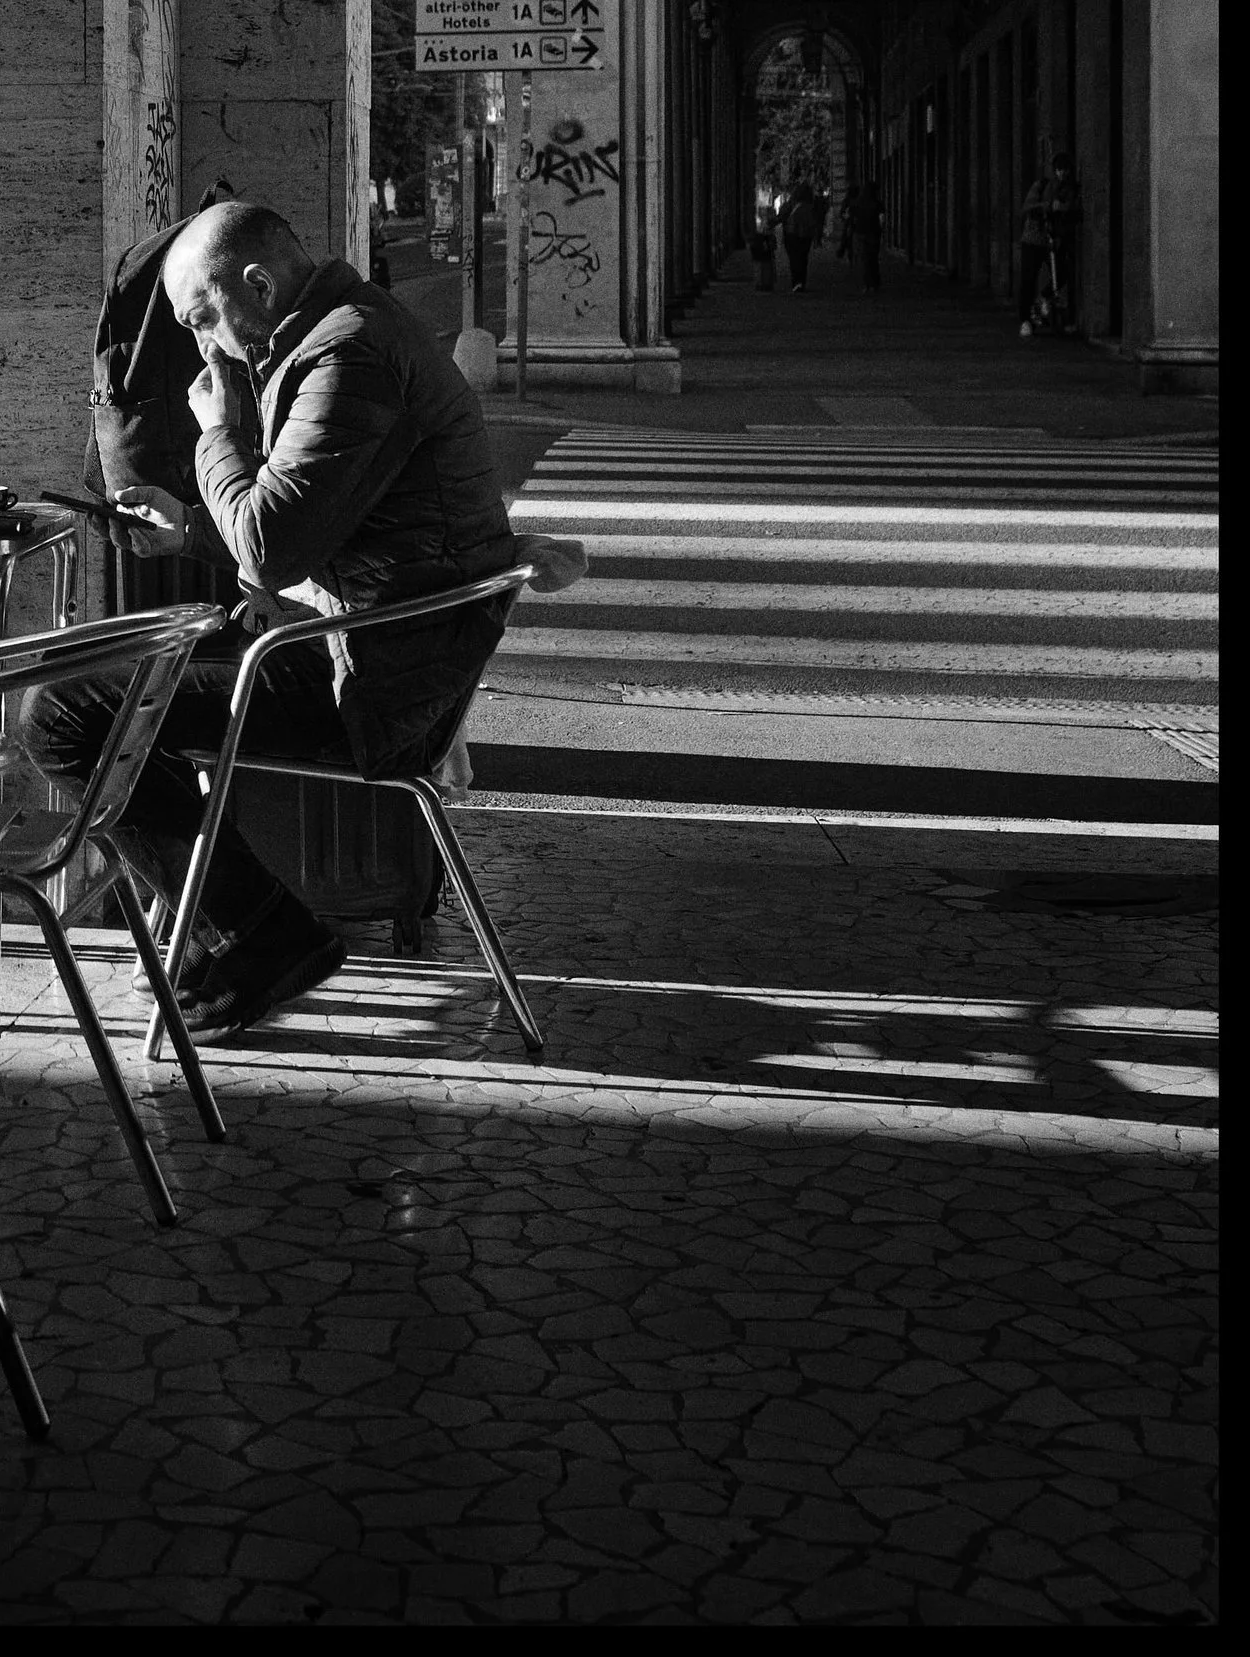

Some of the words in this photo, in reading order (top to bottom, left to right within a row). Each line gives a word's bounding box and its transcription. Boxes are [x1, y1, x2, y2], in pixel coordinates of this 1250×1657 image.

[425, 0, 501, 14] altri-other
[512, 4, 532, 20] 1A
[442, 16, 491, 29] Hotels
[423, 44, 499, 62] Astoria
[512, 42, 533, 59] 1A
